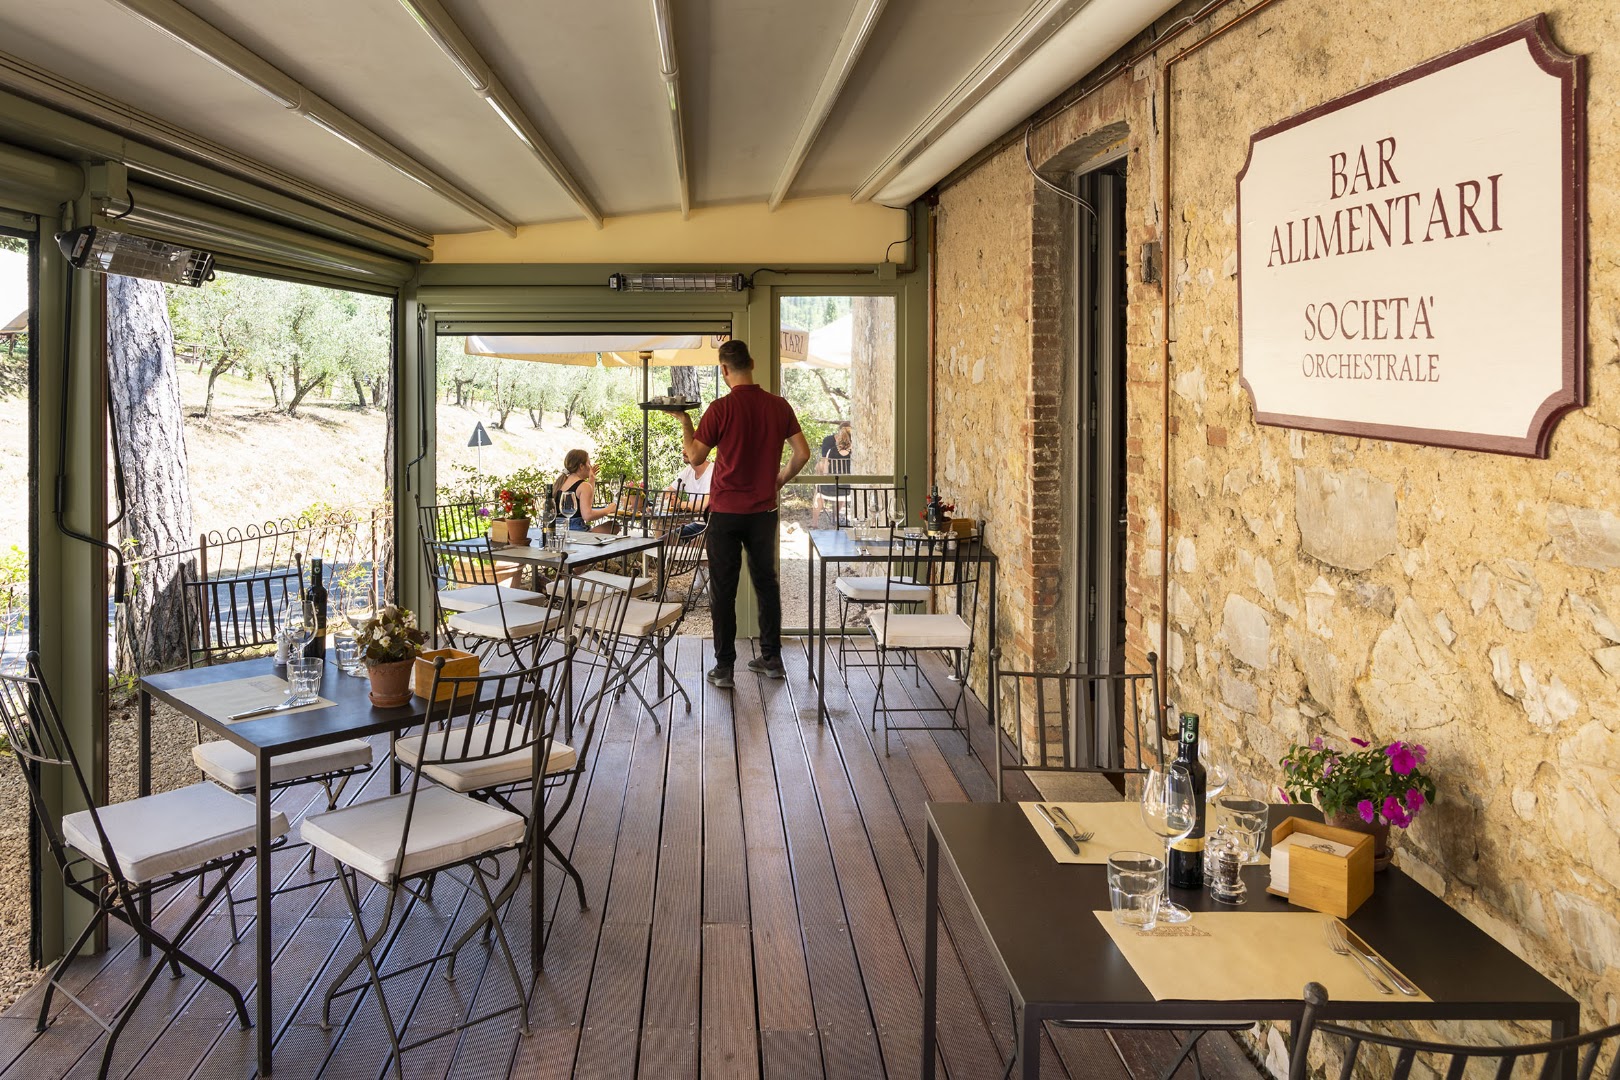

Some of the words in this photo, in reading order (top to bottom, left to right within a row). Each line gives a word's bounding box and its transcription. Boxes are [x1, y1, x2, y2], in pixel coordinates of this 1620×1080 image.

[1329, 136, 1401, 200] BAR
[1267, 173, 1503, 268] ALIMENTARI
[780, 331, 804, 354] TARI
[1302, 353, 1440, 383] ORCHESTRALE
